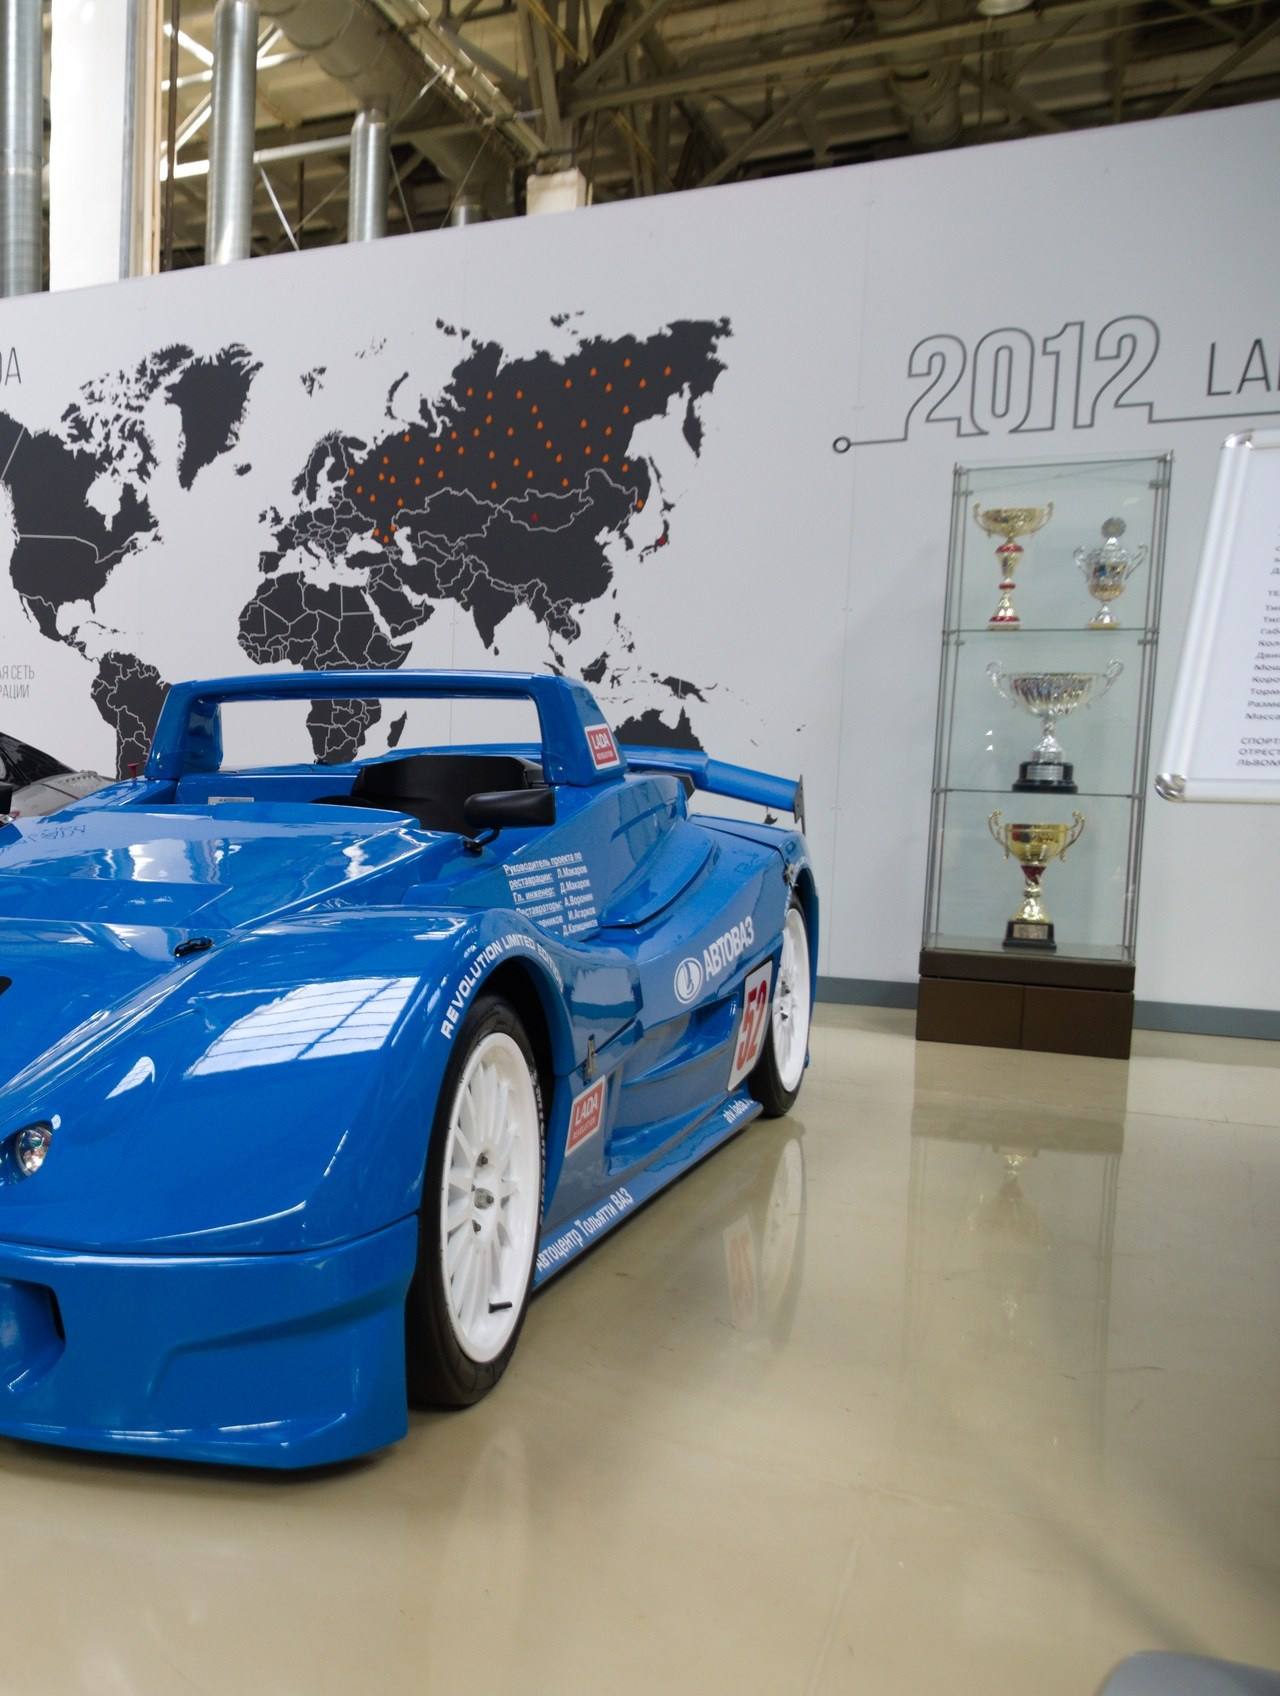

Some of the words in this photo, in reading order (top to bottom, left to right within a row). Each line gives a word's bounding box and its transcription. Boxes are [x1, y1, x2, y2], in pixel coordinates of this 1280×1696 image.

[905, 315, 1160, 437] 2012
[1207, 338, 1280, 396] LA
[11, 665, 35, 680] СЕТЬ
[591, 732, 611, 750] LADA
[550, 853, 574, 867] проекта
[703, 916, 754, 981] АВТОВАЗ
[440, 940, 503, 1039] REVOLUTION
[501, 933, 536, 950] LIMITED
[736, 980, 767, 1070] 52
[575, 1092, 598, 1126] LADA
[536, 1229, 583, 1272] Автоцентр
[574, 1203, 618, 1237] Тольятти
[610, 1187, 634, 1211] ВАЗ
